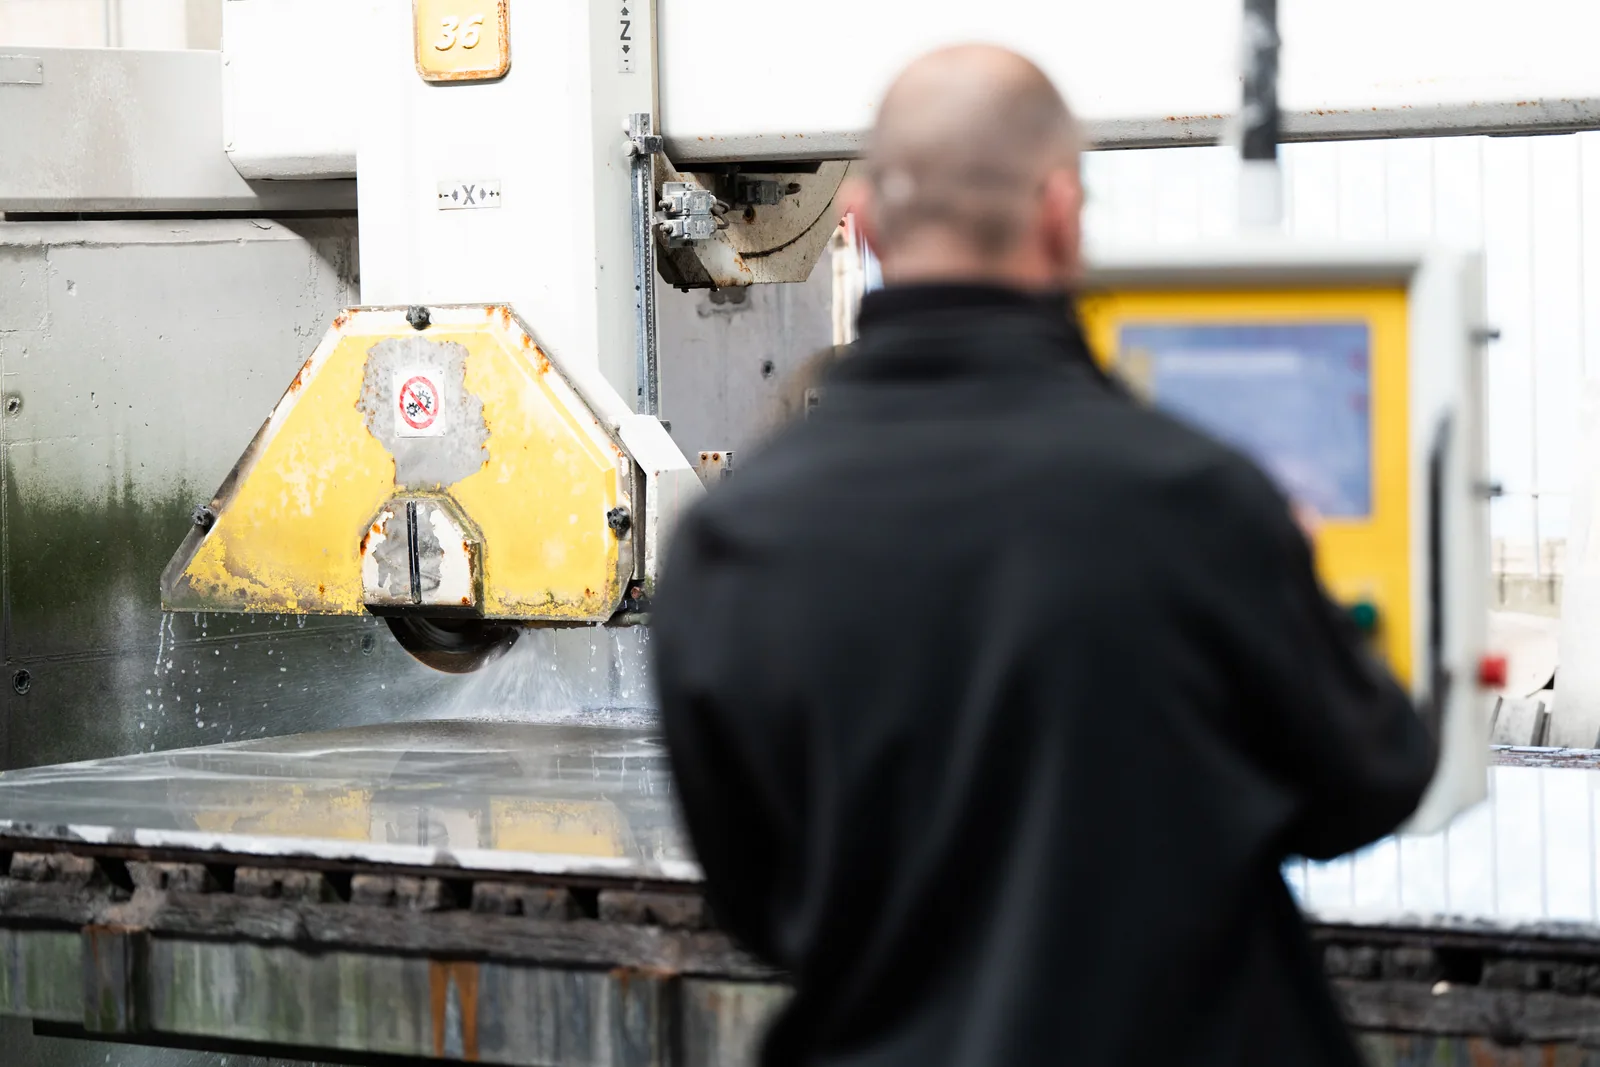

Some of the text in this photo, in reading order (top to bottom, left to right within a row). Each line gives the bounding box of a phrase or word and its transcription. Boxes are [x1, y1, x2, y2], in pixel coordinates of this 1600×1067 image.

[433, 14, 484, 51] 36
[620, 20, 631, 40] Z
[462, 185, 475, 205] X
